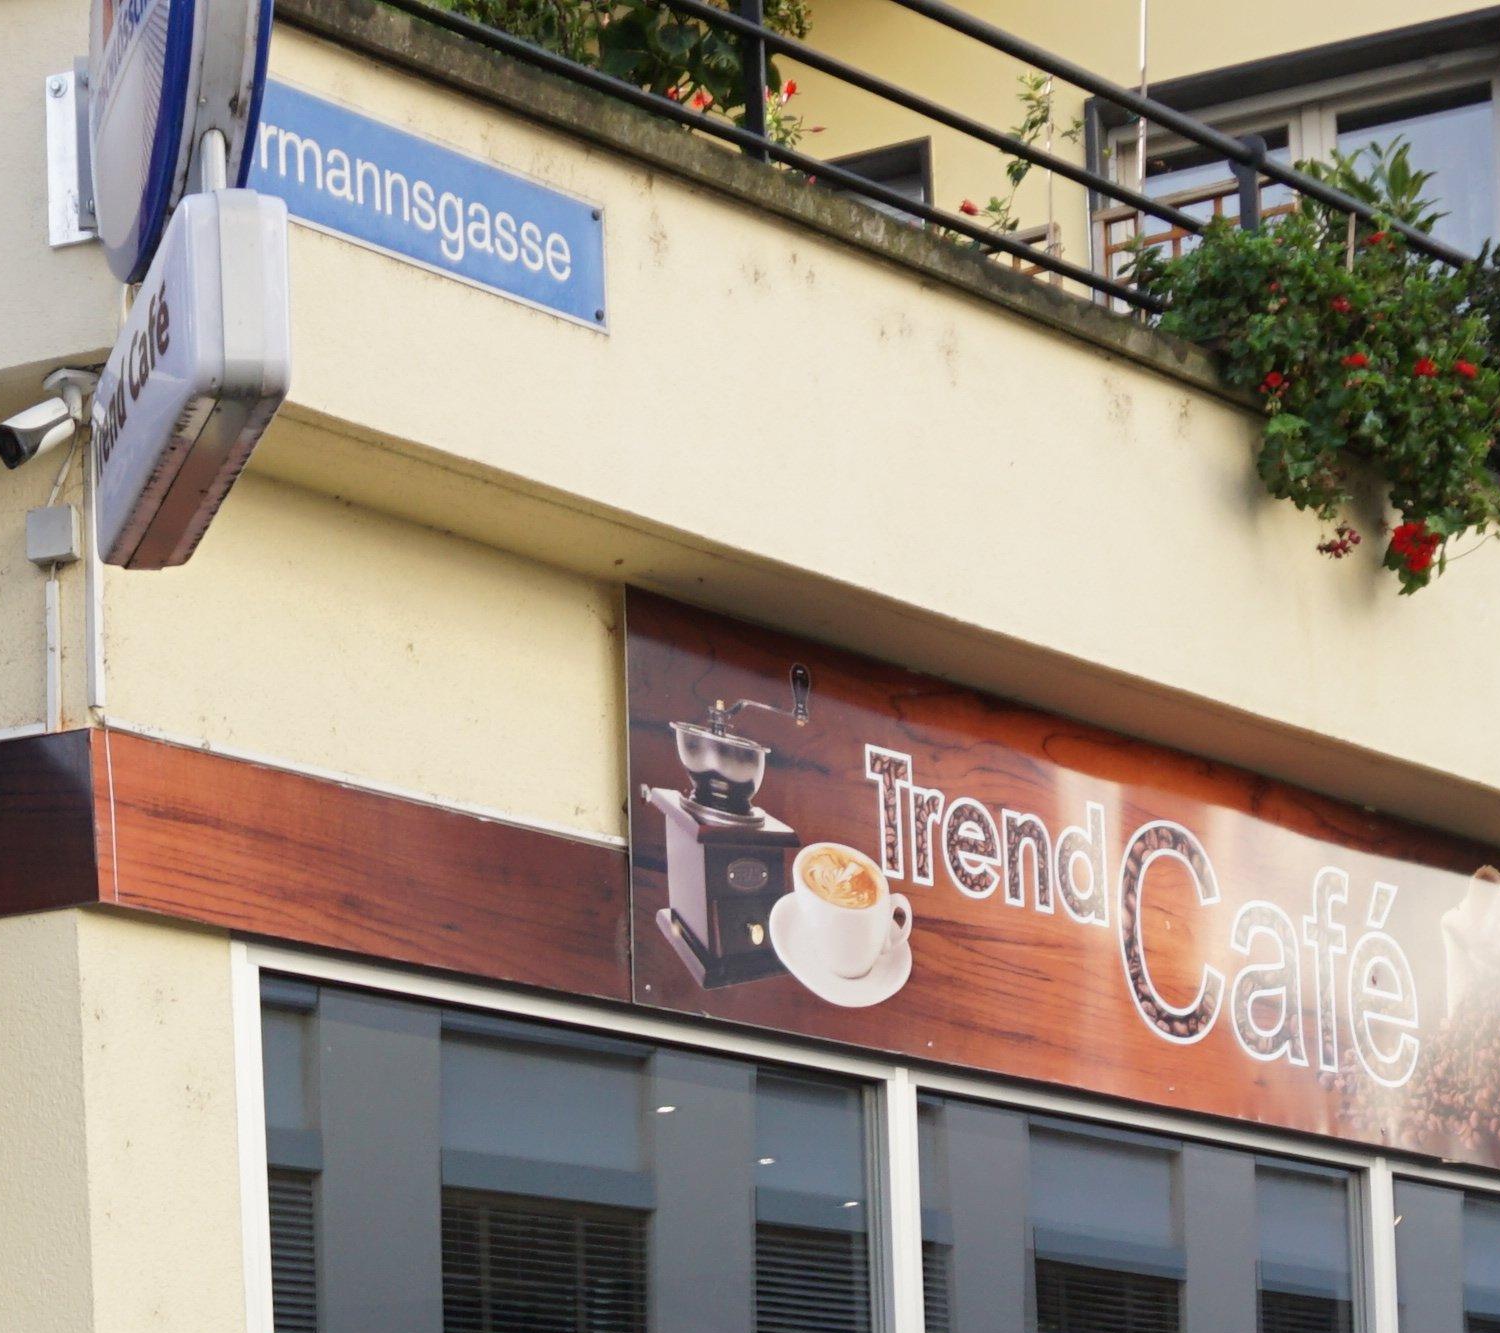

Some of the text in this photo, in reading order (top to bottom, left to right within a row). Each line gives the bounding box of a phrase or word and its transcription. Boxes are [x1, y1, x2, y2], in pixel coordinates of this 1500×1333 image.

[253, 121, 572, 282] rmannsgasse
[128, 279, 170, 402] Café
[864, 743, 1419, 1088] Trend Café
